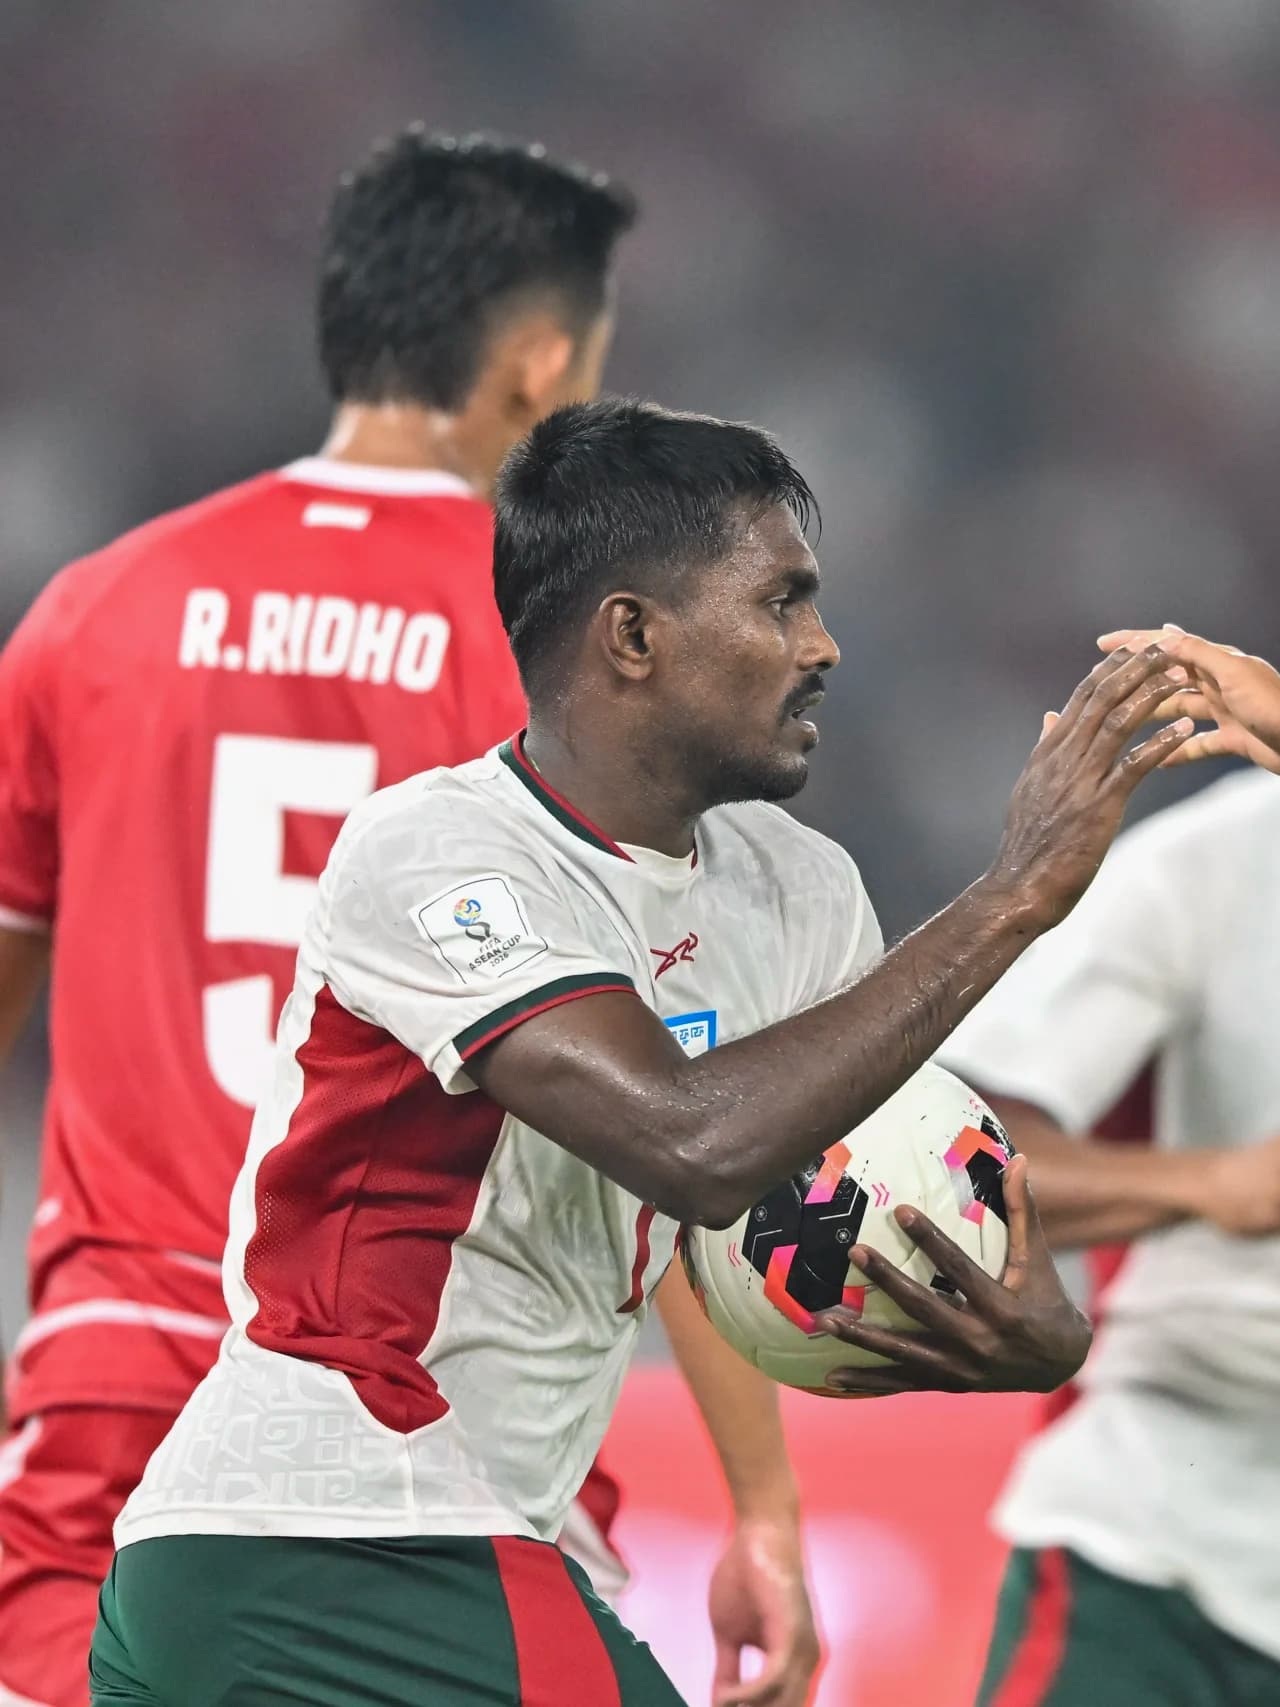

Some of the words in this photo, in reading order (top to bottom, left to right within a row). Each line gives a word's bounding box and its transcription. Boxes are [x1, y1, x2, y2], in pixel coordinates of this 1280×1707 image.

[179, 588, 451, 693] R.RIDHO
[205, 732, 377, 1108] 5
[468, 946, 503, 972] ASEAN
[502, 934, 521, 951] CUP
